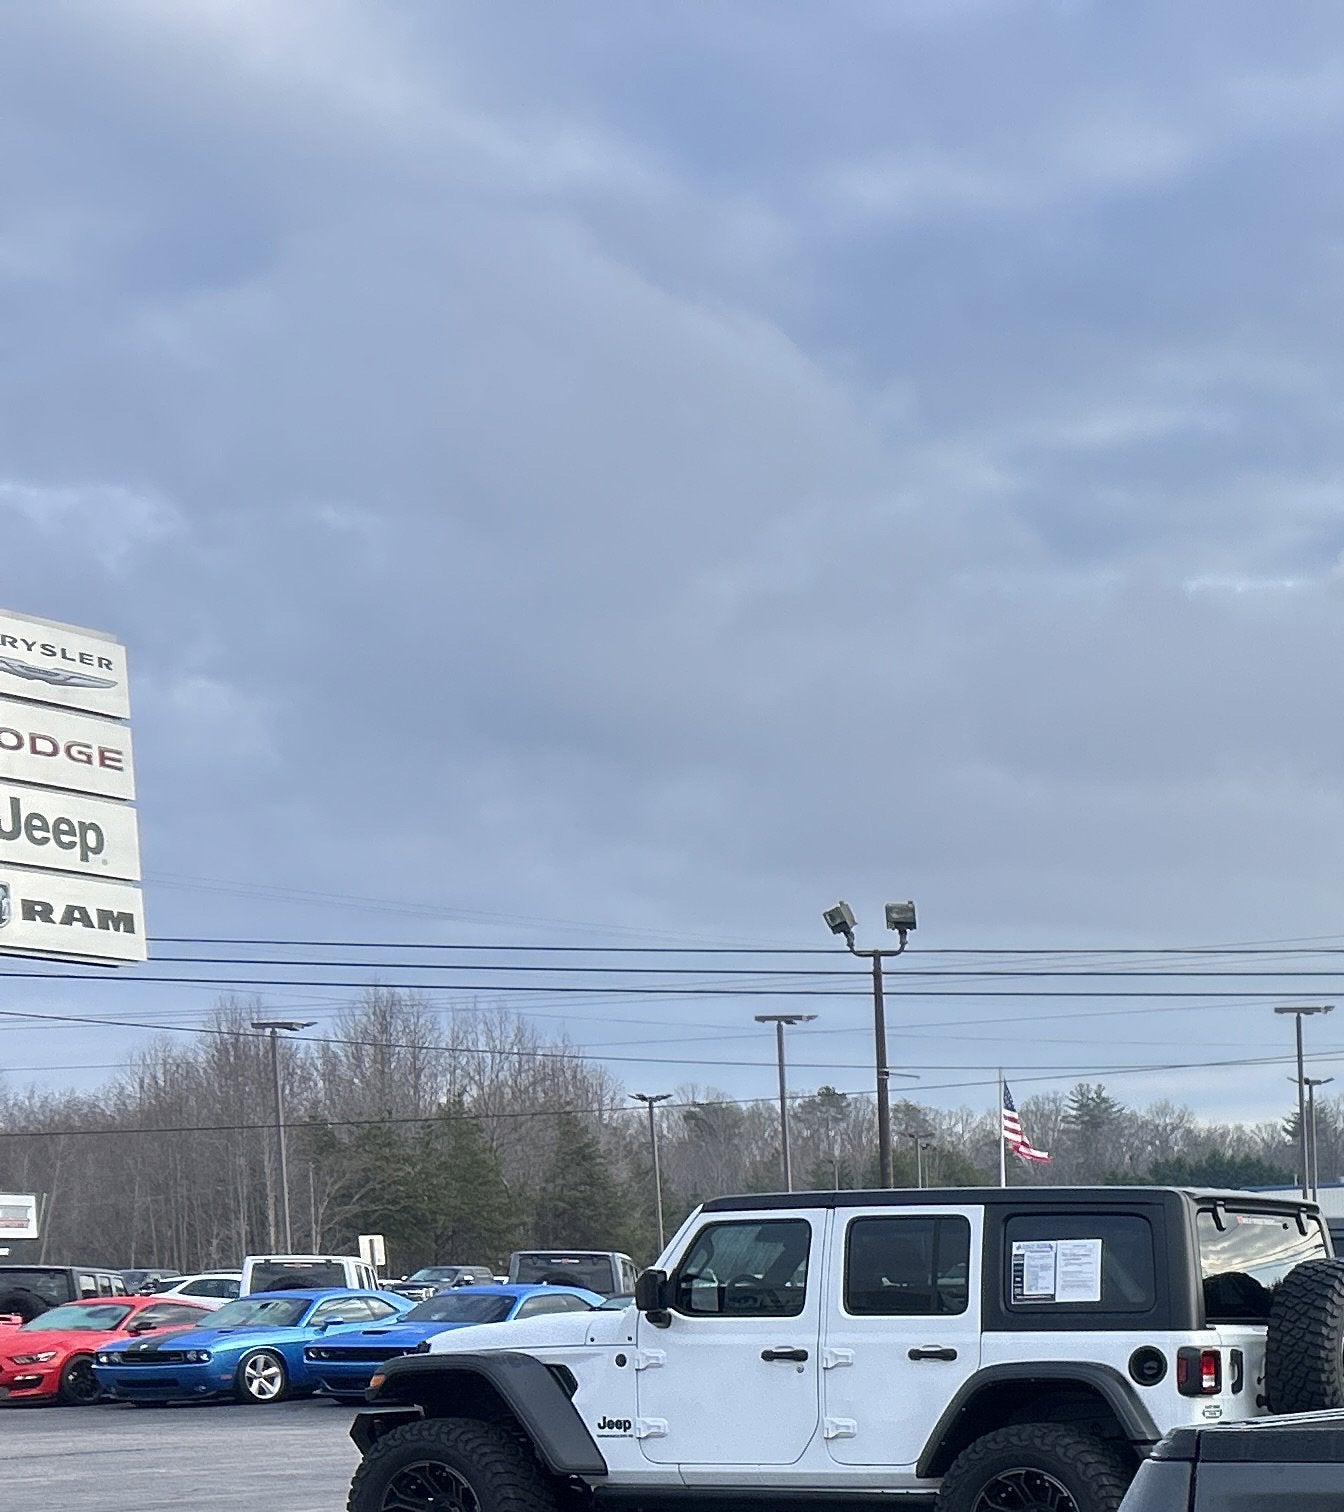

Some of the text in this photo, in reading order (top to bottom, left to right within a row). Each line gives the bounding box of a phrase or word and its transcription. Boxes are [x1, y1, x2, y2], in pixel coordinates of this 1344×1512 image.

[0, 796, 105, 863] Jeep
[20, 898, 136, 935] RAM
[597, 1415, 632, 1433] Jeep
